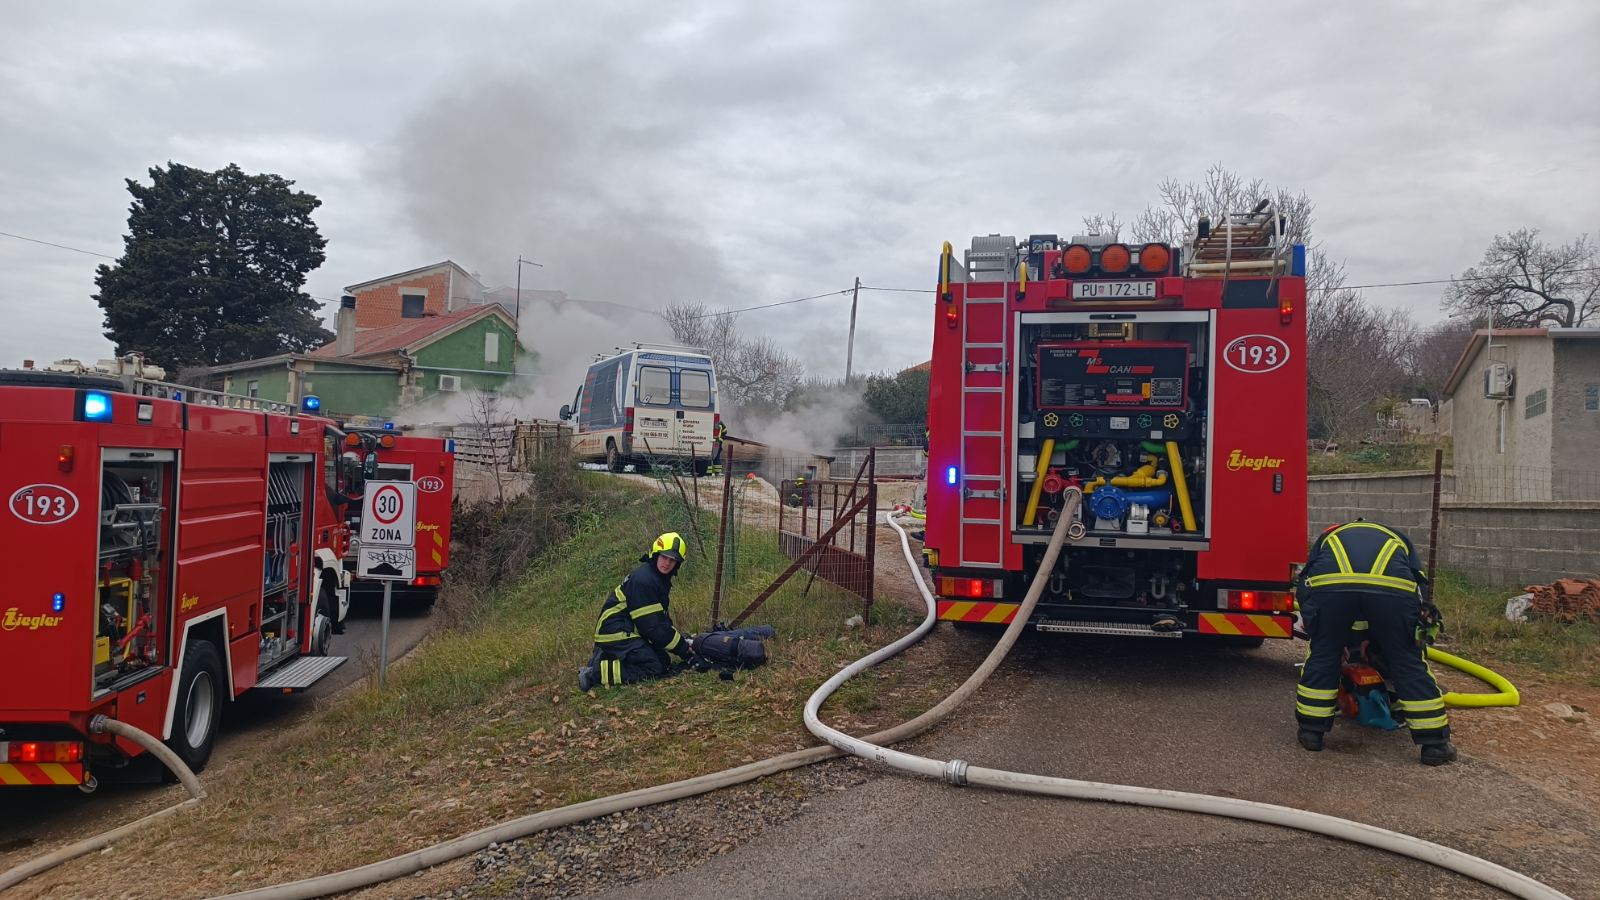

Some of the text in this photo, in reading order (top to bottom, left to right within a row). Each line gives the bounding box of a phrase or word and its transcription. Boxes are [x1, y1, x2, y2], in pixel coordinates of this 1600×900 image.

[1082, 283, 1153, 296] PU 172-LF
[1239, 346, 1278, 365] 193
[1227, 449, 1285, 471] Ziegler
[422, 481, 438, 490] 193
[26, 496, 66, 516] 193
[379, 496, 396, 514] 30
[371, 528, 402, 541] ZONA
[416, 521, 440, 531] Ziegler
[2, 608, 63, 631] Ziegler
